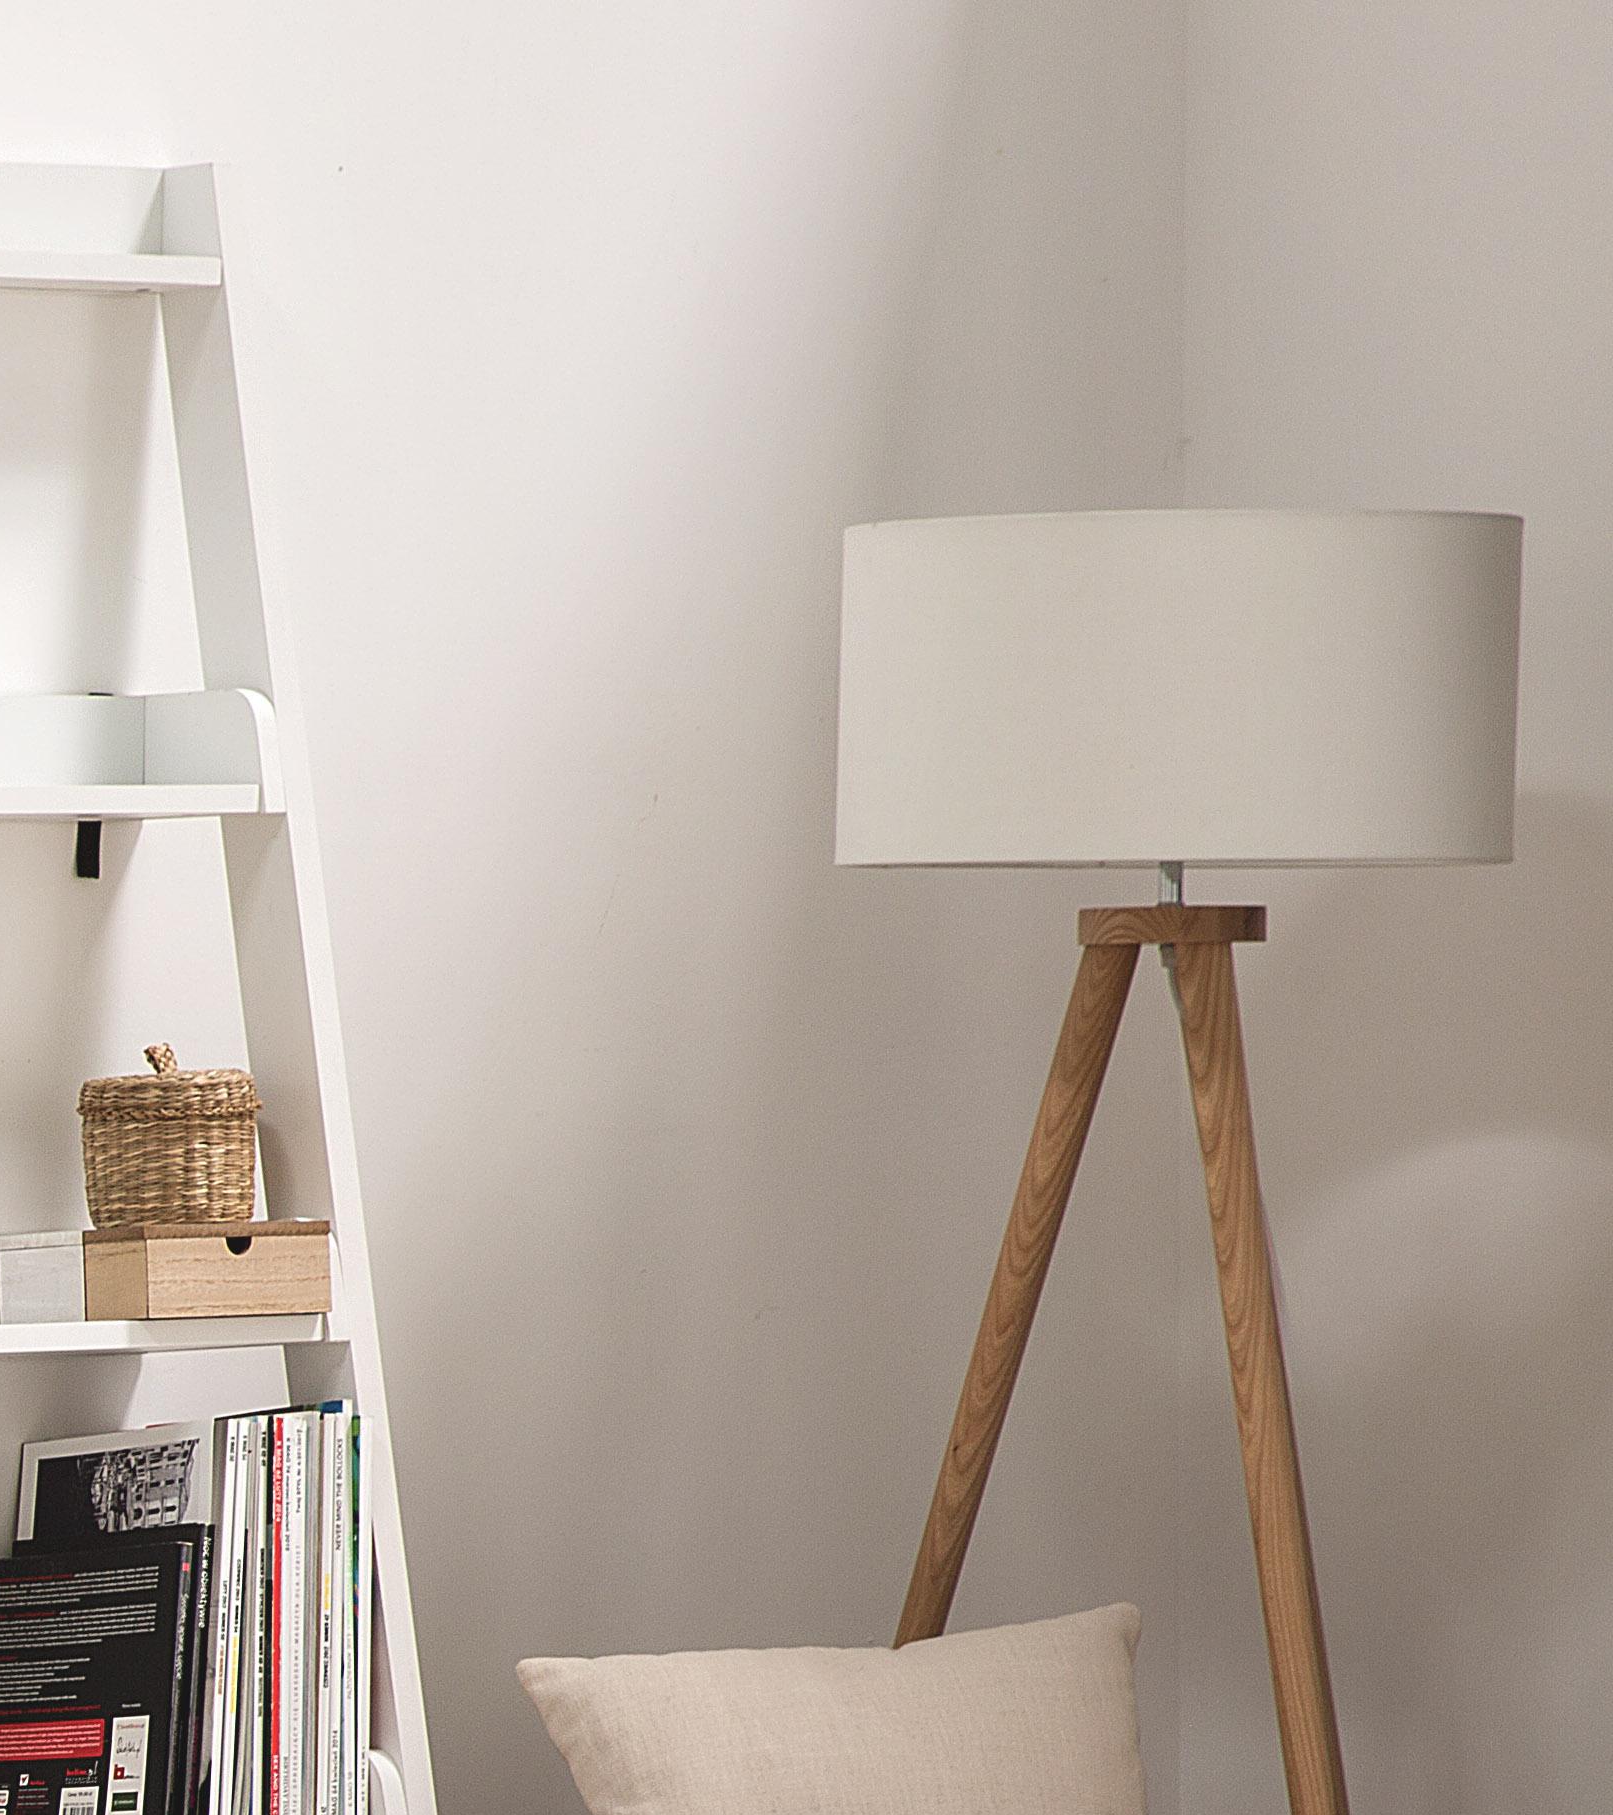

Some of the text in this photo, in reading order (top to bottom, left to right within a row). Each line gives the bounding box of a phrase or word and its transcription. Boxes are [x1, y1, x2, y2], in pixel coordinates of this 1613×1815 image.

[335, 1438, 343, 1479] BOLLOCKS
[197, 1537, 212, 1628] Noc w obiektywie
